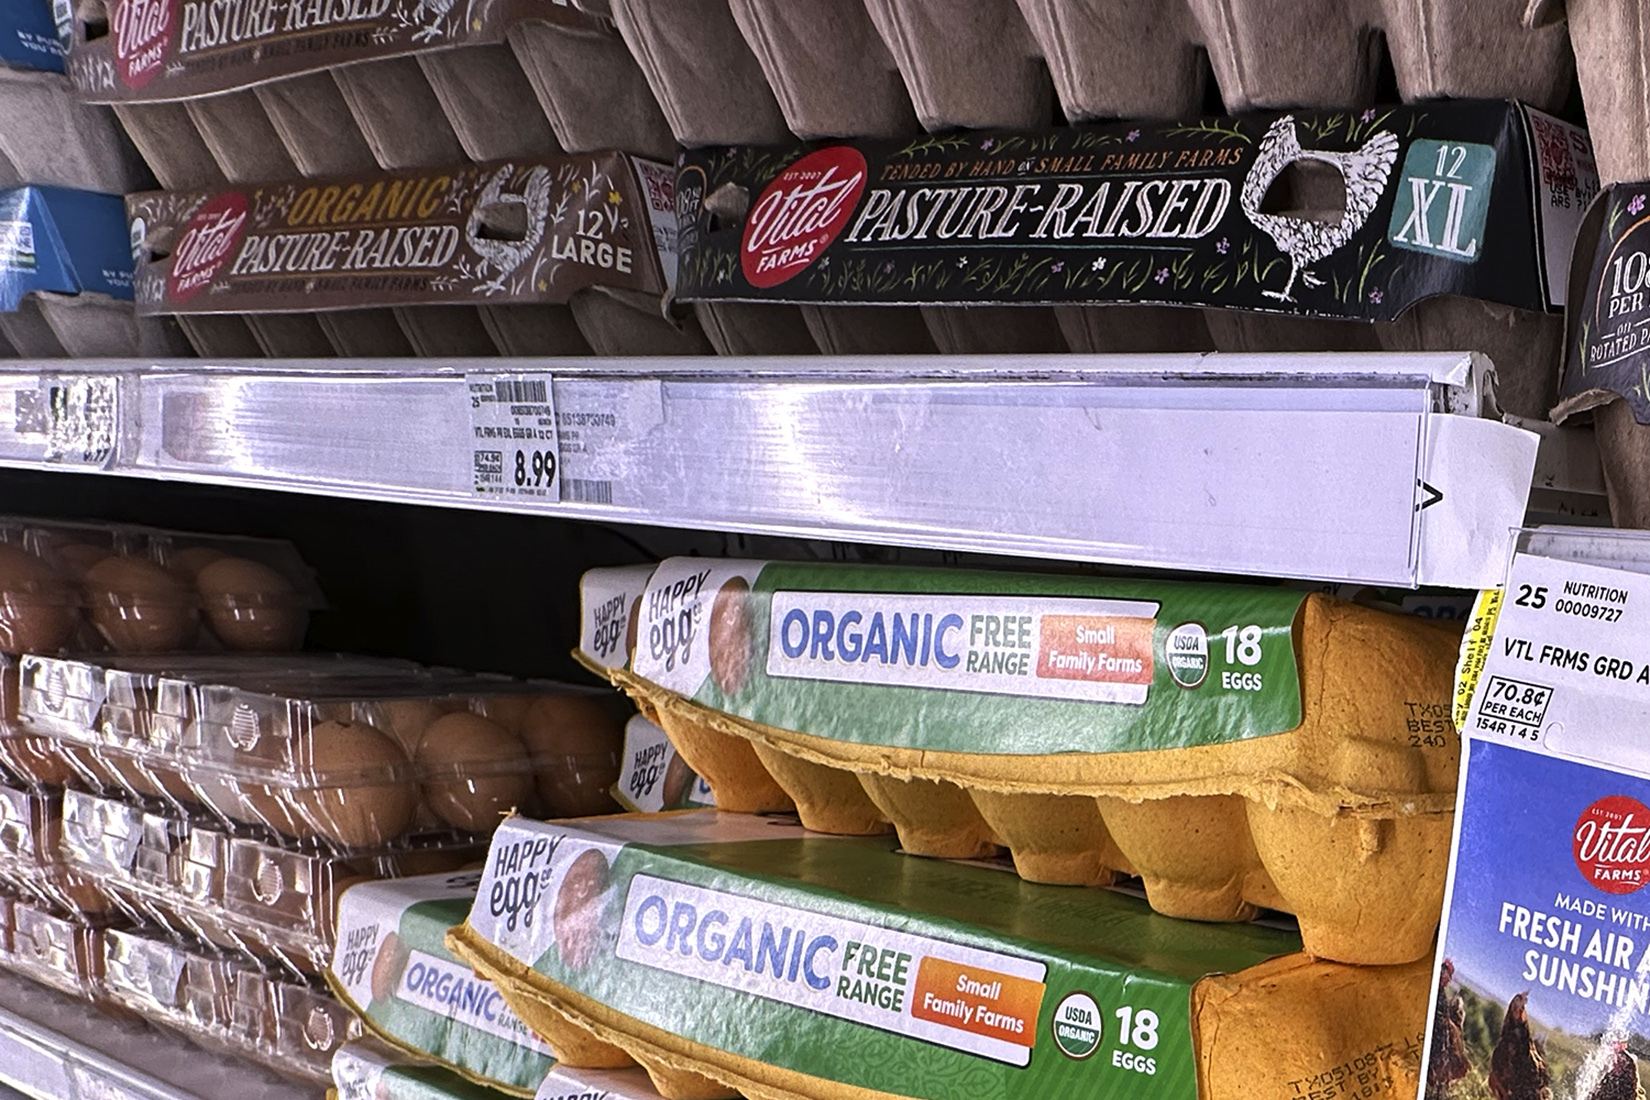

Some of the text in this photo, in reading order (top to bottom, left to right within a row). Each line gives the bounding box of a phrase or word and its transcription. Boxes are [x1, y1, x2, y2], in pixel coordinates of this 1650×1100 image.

[880, 147, 1244, 182] TENDED BY HAND SMALL FAMILY FARMS
[1435, 144, 1464, 178] 12
[288, 176, 451, 226] ORGANIC
[747, 167, 862, 252] Vital
[844, 178, 1231, 243] PASTURE-RAISED
[1393, 178, 1477, 258] XL
[576, 209, 605, 241] 12
[230, 226, 458, 276] PASTURE-RAISED
[1607, 292, 1646, 319] PER
[1589, 331, 1638, 363] ROTATED
[515, 449, 556, 488] 8.99
[1515, 580, 1628, 610] 25 NUTRITION
[1555, 598, 1623, 623] 00009727
[781, 607, 1116, 670] ORGANIC FREE Small
[1173, 633, 1200, 653] USDA
[1222, 624, 1263, 667] 18
[966, 650, 1143, 677] RANGE Family Farms
[1462, 640, 1478, 675] Shelf
[1502, 637, 1534, 663] VTL
[1539, 644, 1589, 673] FRMS
[1593, 656, 1633, 683] GRD
[1637, 664, 1650, 685] A
[1221, 671, 1263, 691] EGGS
[1491, 680, 1545, 707] 70.8¢
[1476, 718, 1506, 735] 154R
[1484, 701, 1542, 724] PER EACH
[1594, 868, 1642, 883] FARMS
[490, 871, 543, 932] egg
[1555, 892, 1606, 920] MADE
[634, 893, 1002, 1002] ORGANIC FREE Small
[406, 961, 501, 1022] ORGANIC
[836, 978, 1025, 1035] RANGE Family Farms
[1064, 1004, 1093, 1027] USDA
[1115, 1005, 1160, 1051] 18
[1057, 1024, 1096, 1045] ORGANIC
[1111, 1050, 1158, 1076] EGGS
